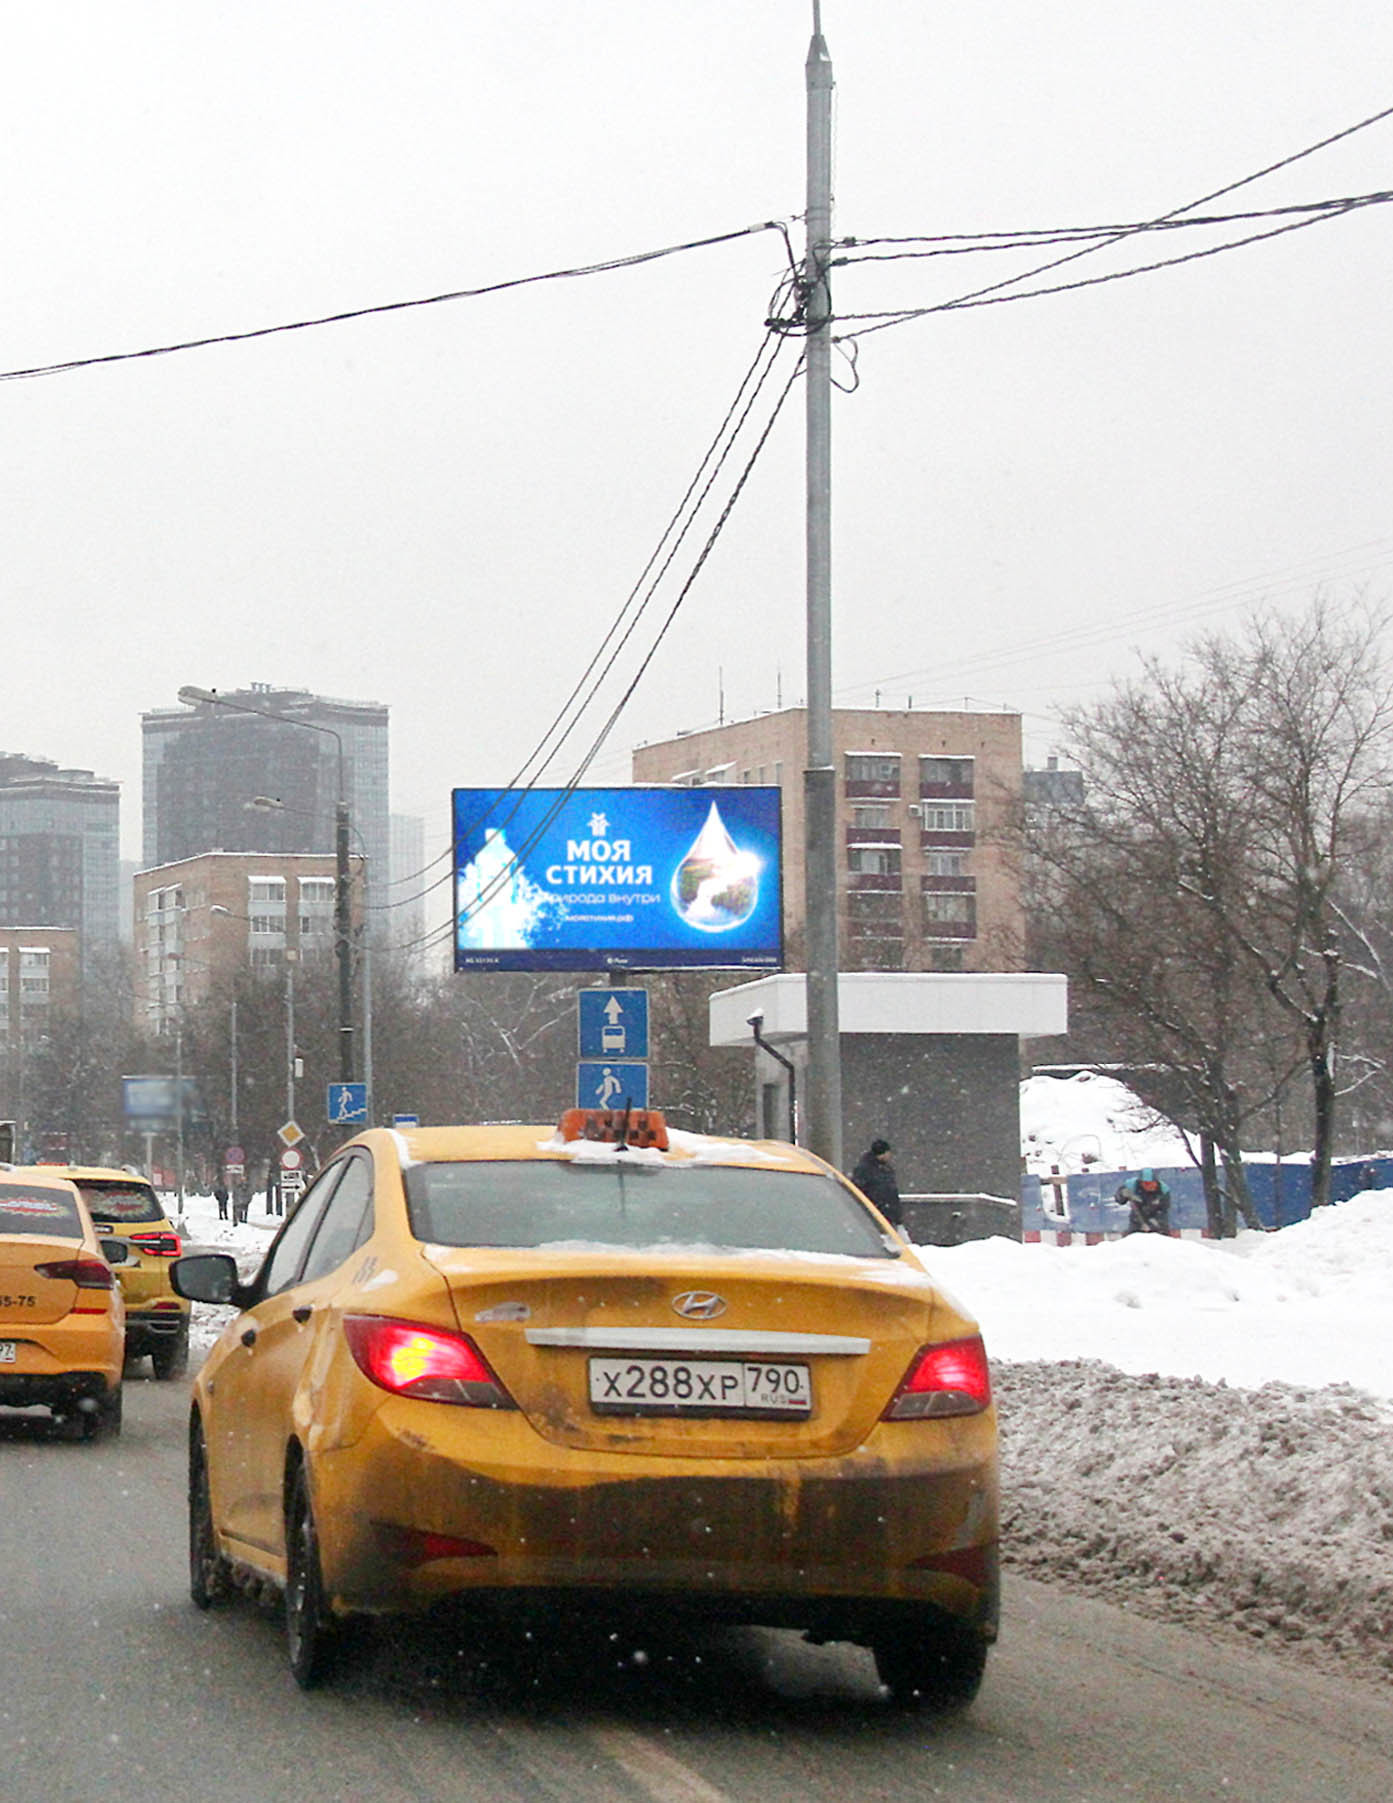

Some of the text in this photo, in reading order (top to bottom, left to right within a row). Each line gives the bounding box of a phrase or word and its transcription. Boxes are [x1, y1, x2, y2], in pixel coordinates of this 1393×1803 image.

[567, 839, 631, 861] МОЯ
[546, 865, 653, 885] СТИХИЯ
[608, 893, 661, 905] внутри
[603, 1365, 800, 1401] Х288ХР 790
